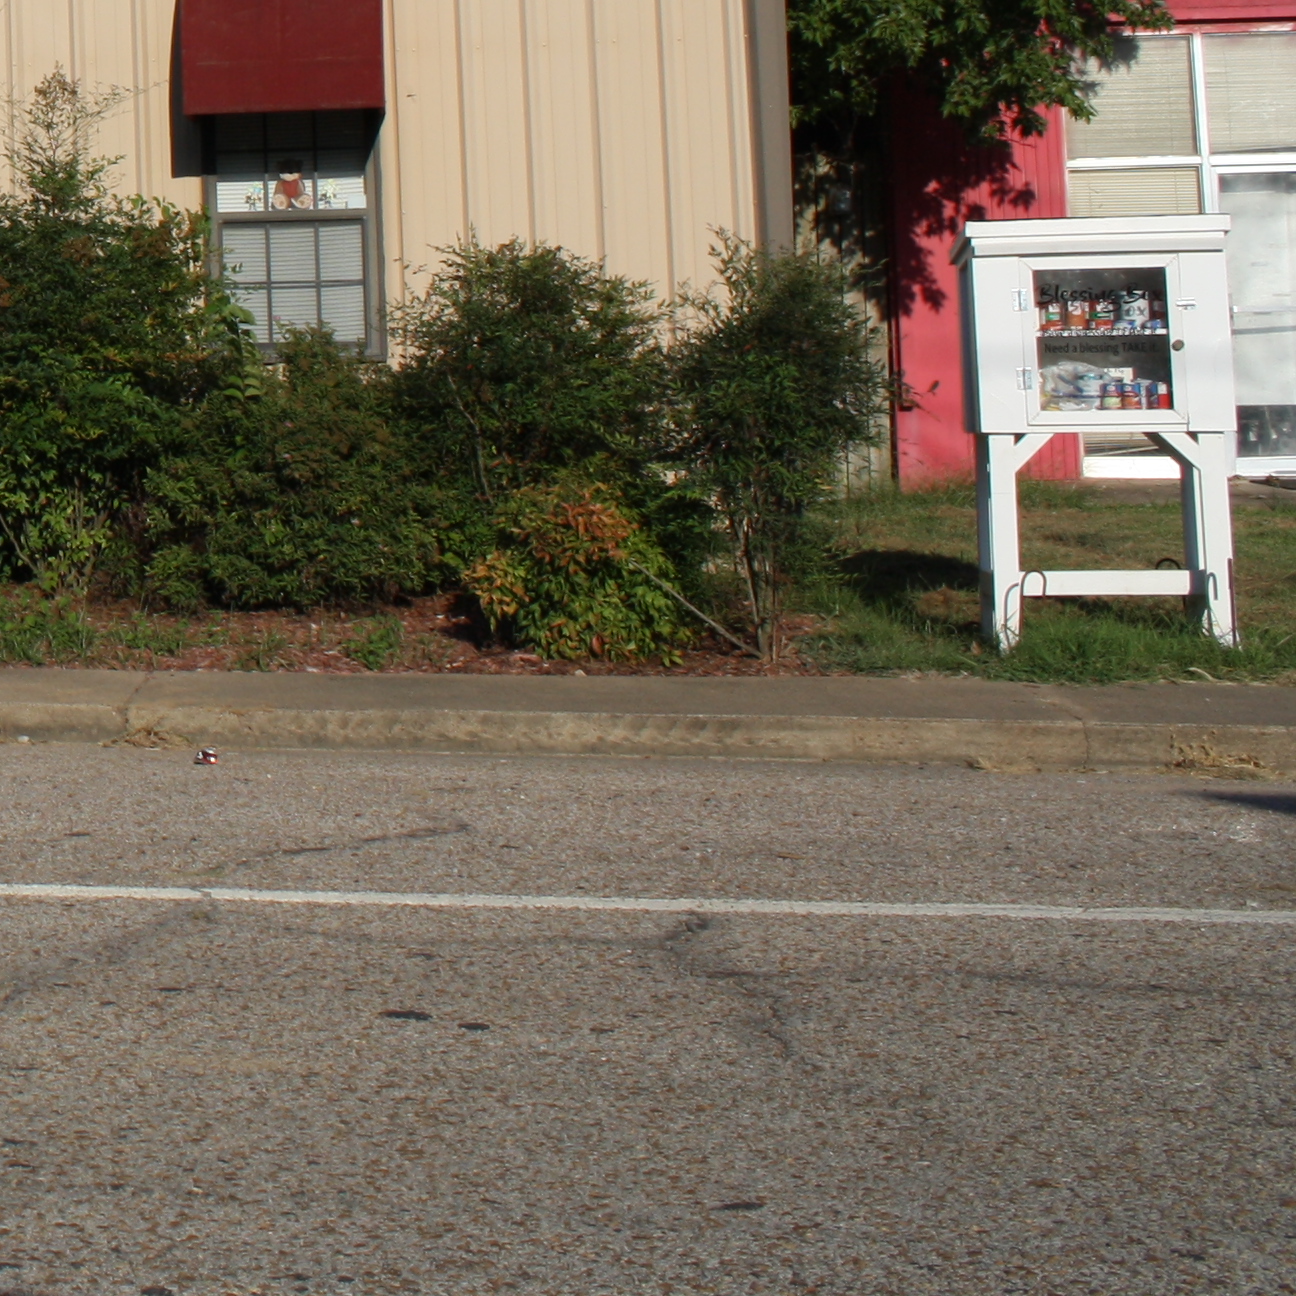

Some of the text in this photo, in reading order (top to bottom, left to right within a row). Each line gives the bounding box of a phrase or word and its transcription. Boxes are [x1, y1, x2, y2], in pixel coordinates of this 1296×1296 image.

[1039, 284, 1122, 313] Blessing
[1044, 342, 1069, 353] Need
[1071, 345, 1077, 353] a
[1079, 342, 1119, 356] blessing
[1122, 342, 1146, 353] TAKE
